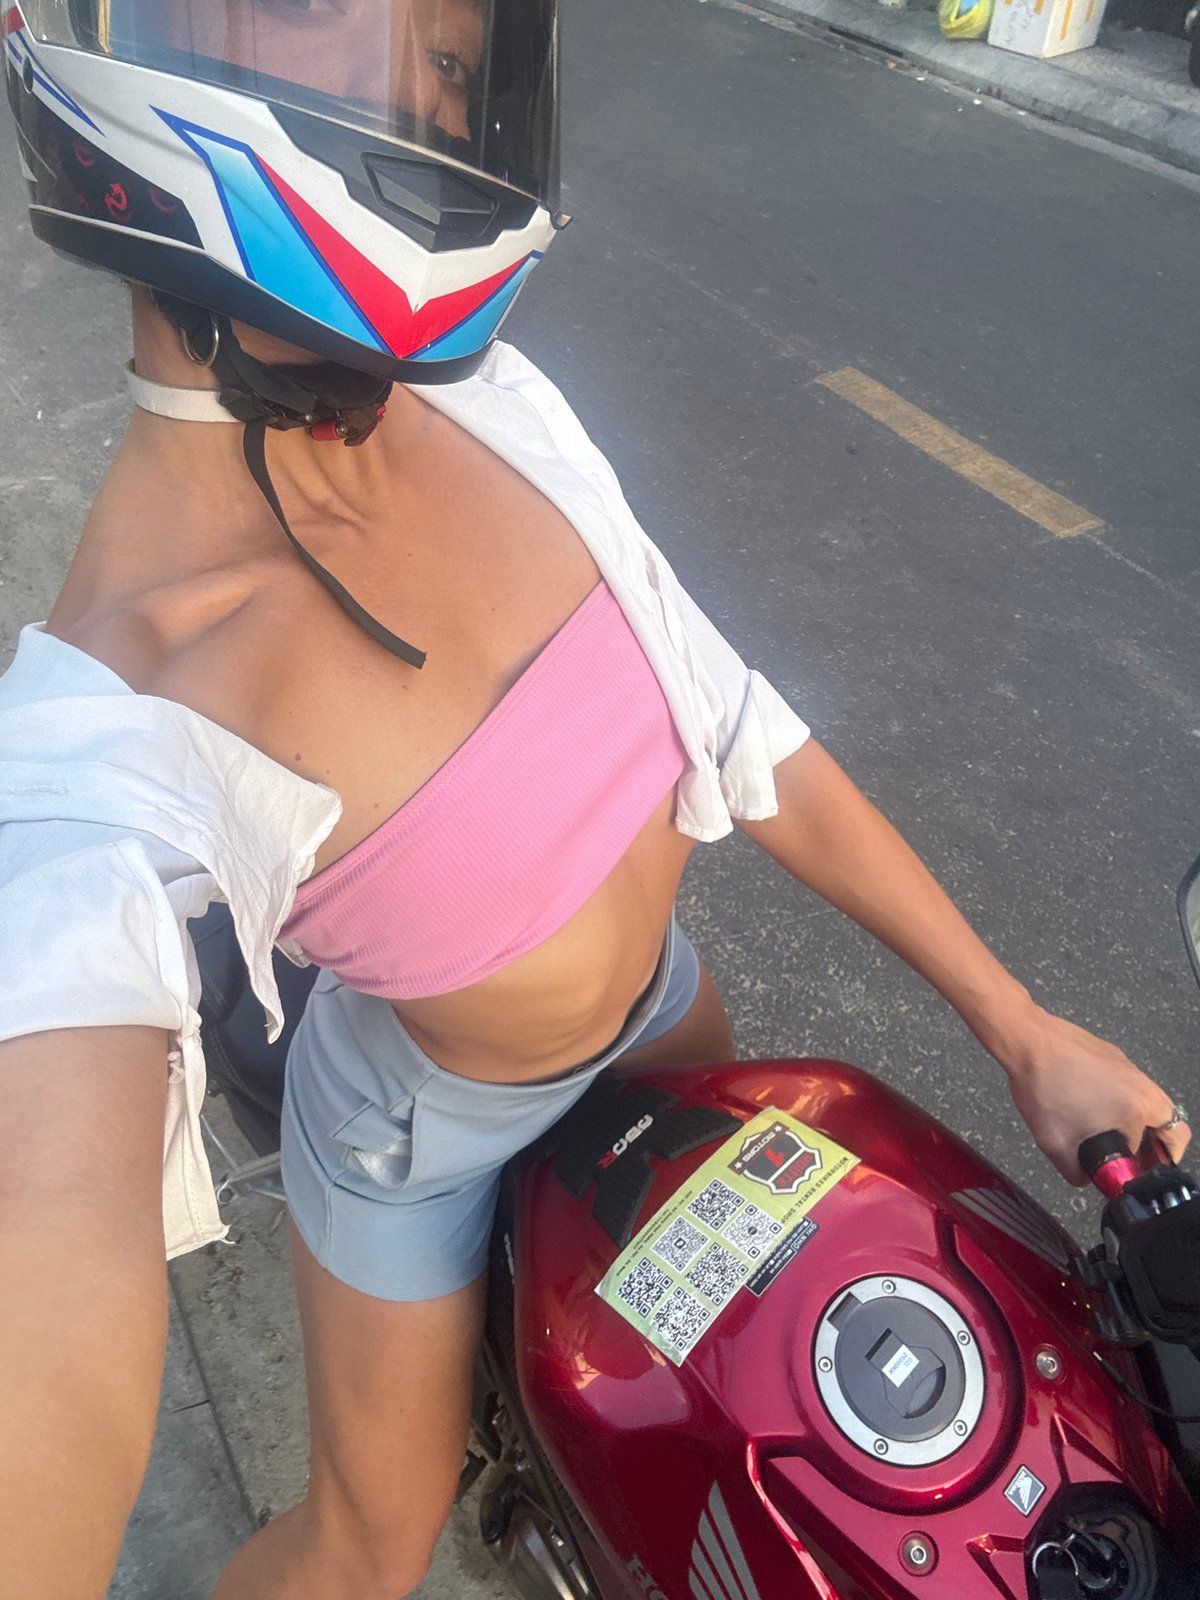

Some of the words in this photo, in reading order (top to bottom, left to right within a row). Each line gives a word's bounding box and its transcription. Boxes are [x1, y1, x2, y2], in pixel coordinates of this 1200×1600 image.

[741, 1130, 775, 1162] MOTORS
[814, 1156, 848, 1188] MOTORBIKES
[794, 1186, 816, 1209] RENTAL
[779, 1207, 796, 1224] SHOP
